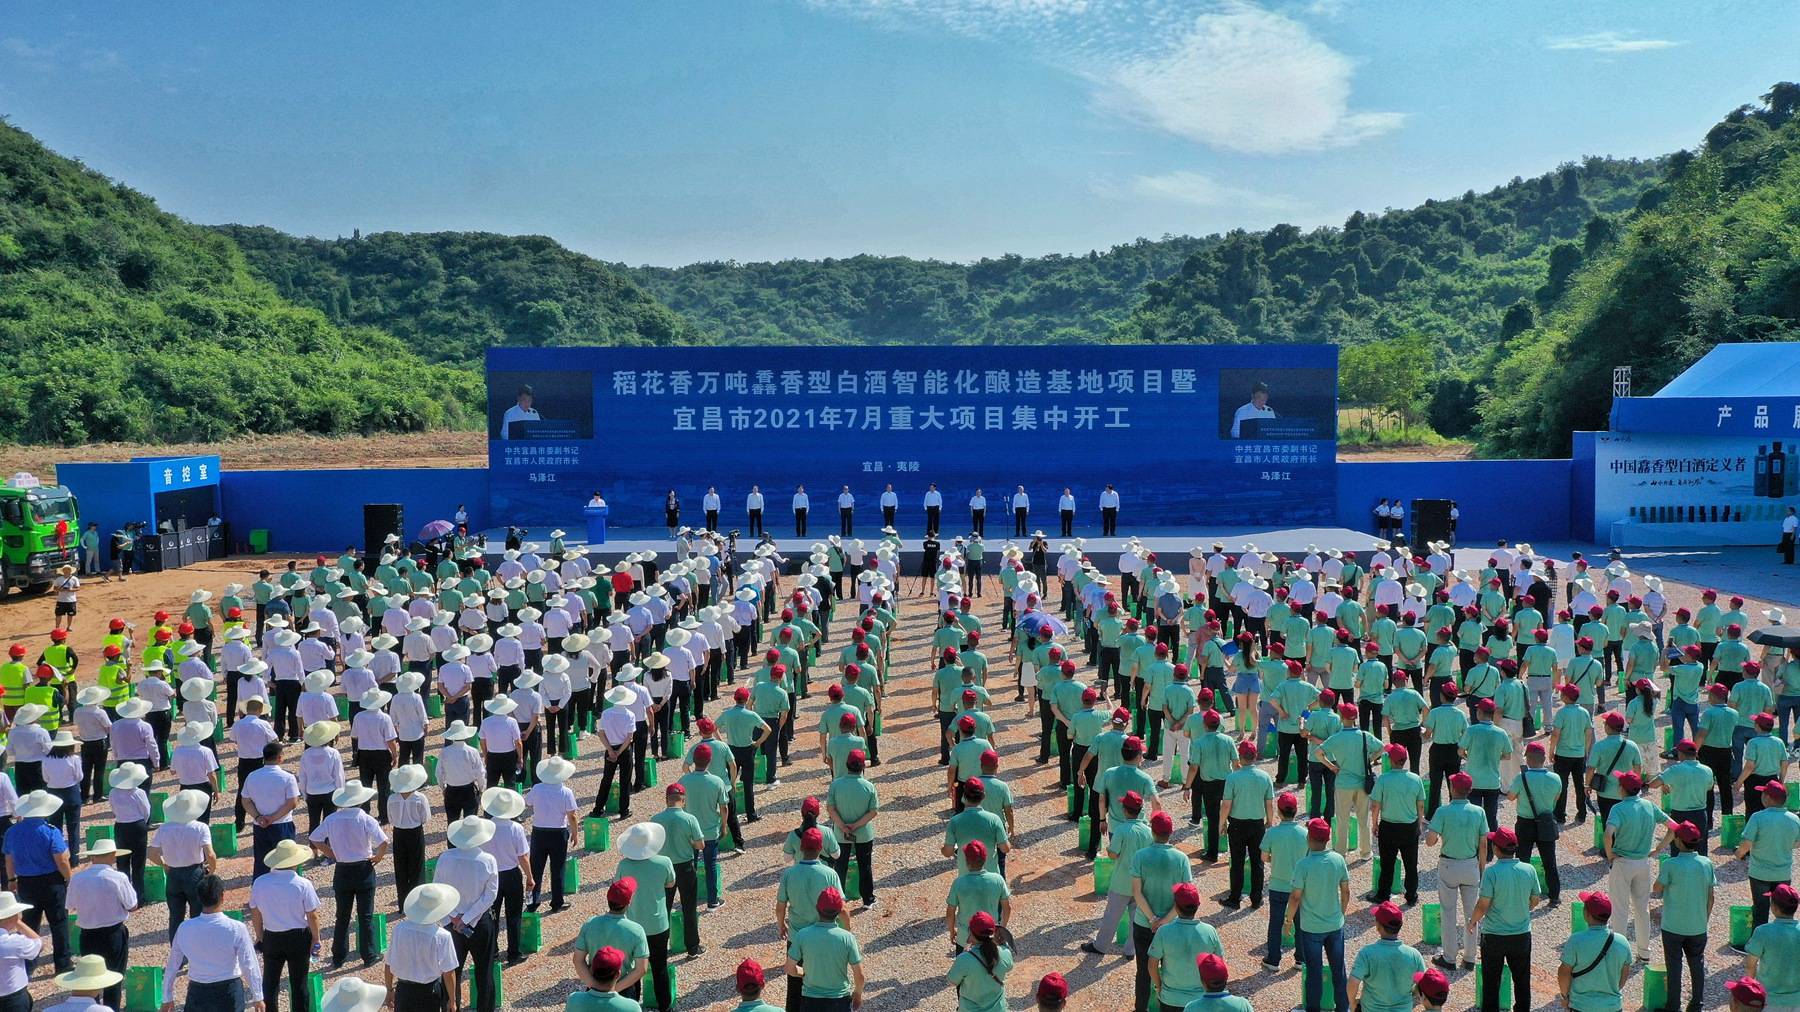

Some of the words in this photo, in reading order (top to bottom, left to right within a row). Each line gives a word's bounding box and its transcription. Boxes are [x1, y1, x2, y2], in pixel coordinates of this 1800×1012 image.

[613, 369, 1197, 396] 稻花香万吨馫香型白酒智能化酿造基地项目暨
[673, 406, 1131, 432] 宜昌市2021年7月重大项目集中开工
[504, 446, 579, 455] 中共宜昌市委副书记
[1235, 445, 1318, 453] 中共宜昌市委副书记
[504, 457, 580, 465] 宜昌市人民政府市长
[1234, 455, 1317, 464] 宜昌市人民政府市长
[163, 463, 208, 486] 音控室
